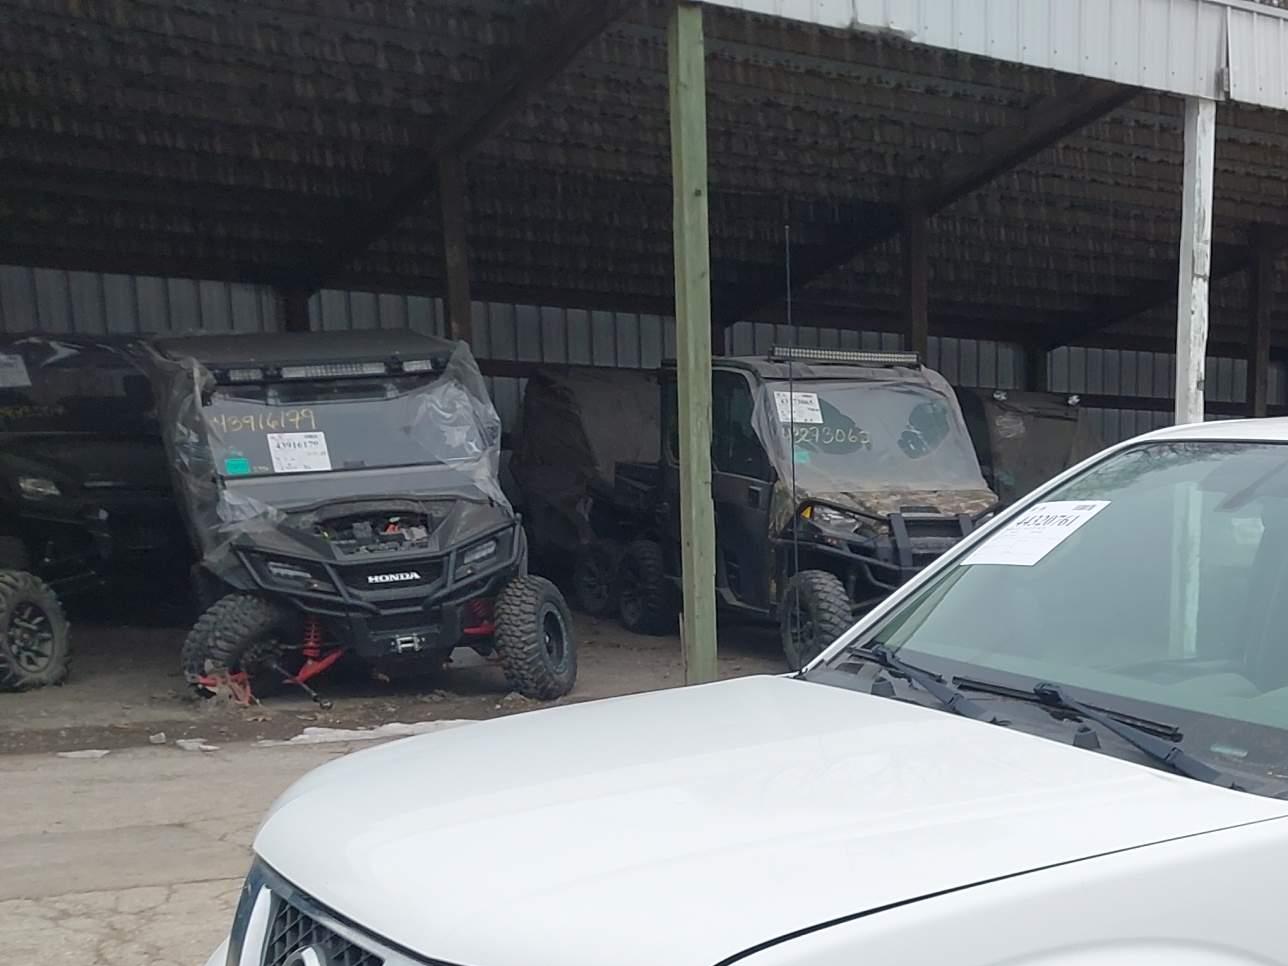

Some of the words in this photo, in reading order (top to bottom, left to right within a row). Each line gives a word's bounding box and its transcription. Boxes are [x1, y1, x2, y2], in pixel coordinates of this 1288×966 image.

[213, 408, 316, 433] 43916179
[1015, 513, 1081, 528] 44320761
[367, 572, 421, 584] HONDA
